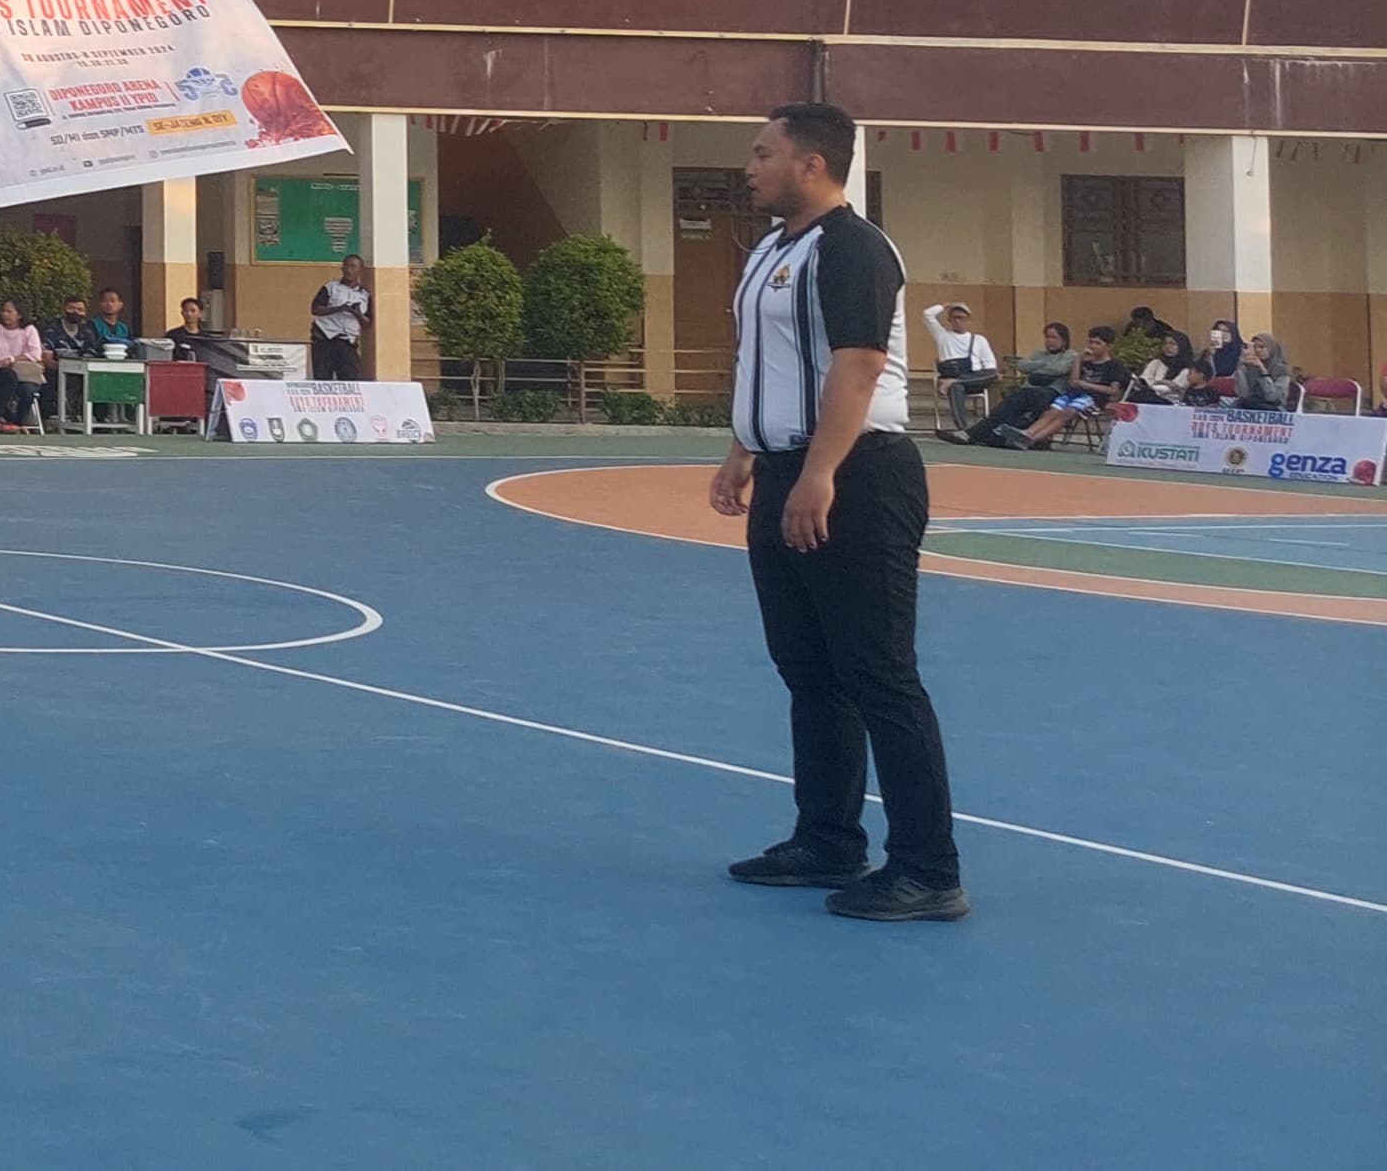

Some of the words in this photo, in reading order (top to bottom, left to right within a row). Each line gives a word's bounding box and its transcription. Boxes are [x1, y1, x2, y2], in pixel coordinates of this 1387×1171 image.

[8, 18, 71, 36] ISLAM
[80, 5, 210, 36] DIPONEGORO
[49, 81, 121, 101] DIPONEGORO
[123, 78, 162, 92] ARENA
[69, 94, 119, 112] KAMPUS
[1226, 409, 1295, 426] BASKETBALL
[1137, 446, 1200, 462] KUSTATI
[1268, 451, 1347, 478] genza
